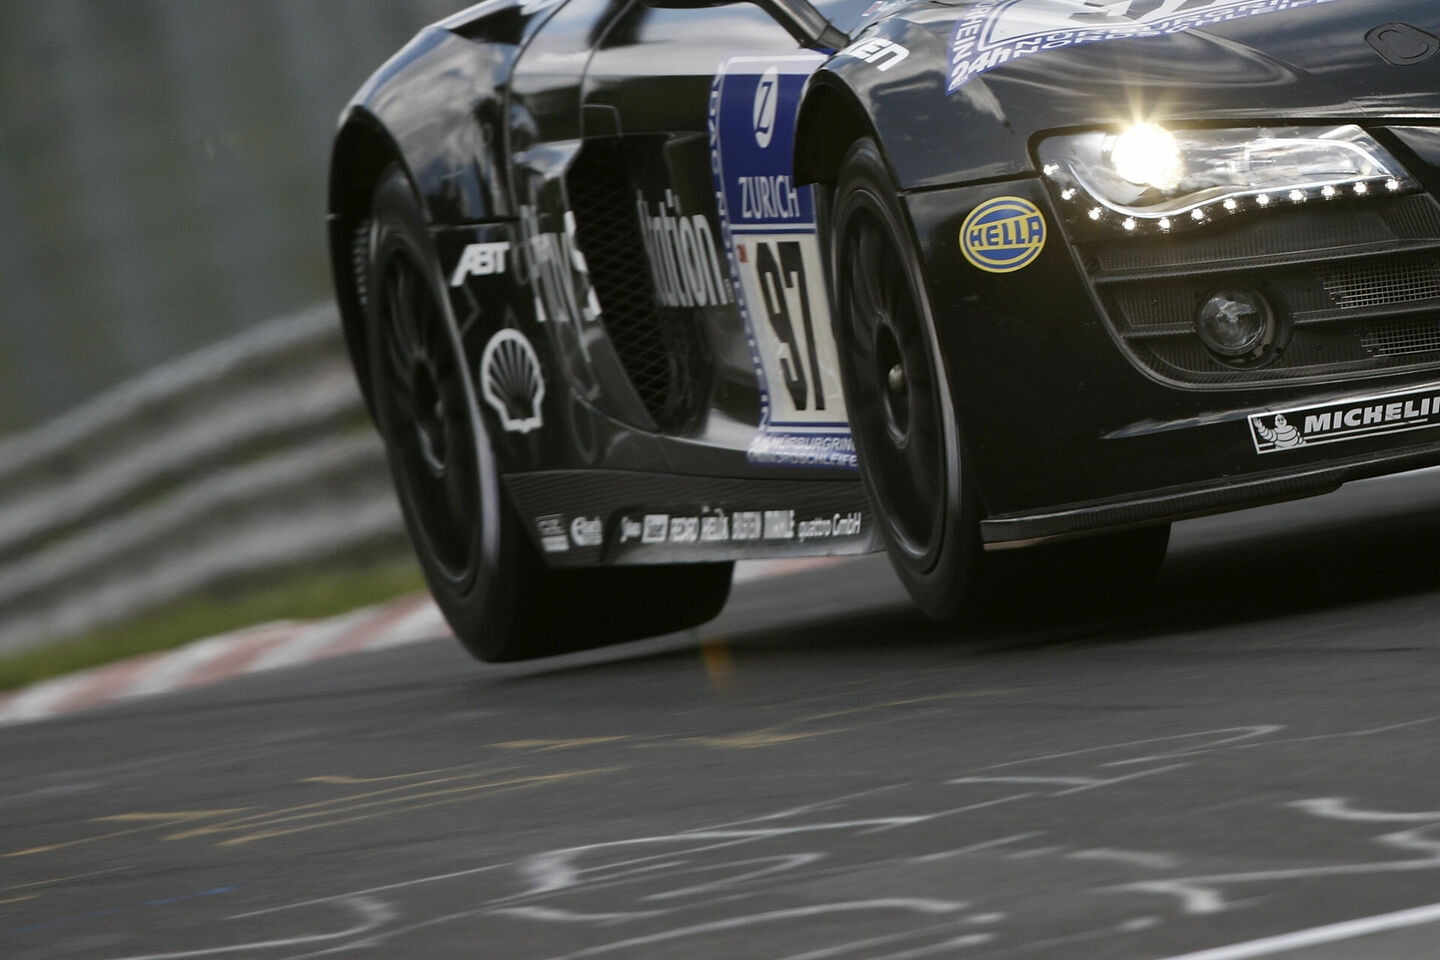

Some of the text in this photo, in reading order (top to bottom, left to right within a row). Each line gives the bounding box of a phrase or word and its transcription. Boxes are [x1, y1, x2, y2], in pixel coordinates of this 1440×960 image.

[948, 47, 1012, 92] 24h
[737, 174, 799, 219] ZURICH
[969, 220, 1043, 248] HELLA
[450, 241, 511, 288] ABT
[755, 241, 827, 412] 97
